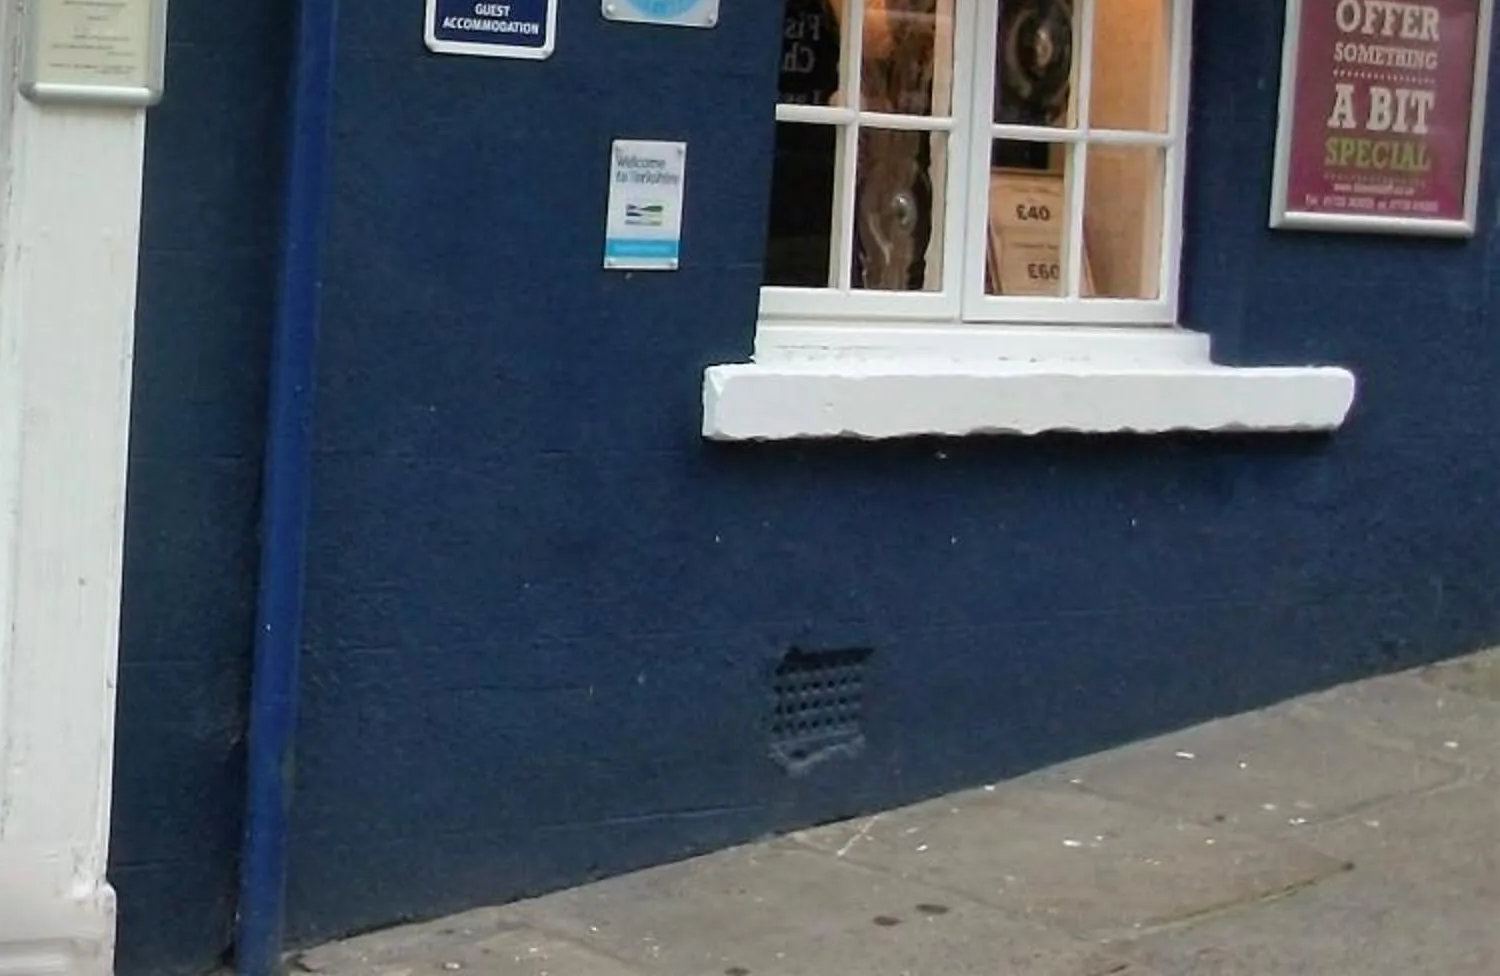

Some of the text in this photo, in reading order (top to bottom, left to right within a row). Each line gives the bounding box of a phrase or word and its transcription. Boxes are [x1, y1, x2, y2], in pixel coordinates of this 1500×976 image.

[475, 3, 510, 17] GUEST
[442, 18, 539, 36] ACCOMMODATION
[1333, 42, 1438, 70] SOMETHING
[1327, 84, 1435, 134] A BIT
[1323, 136, 1432, 173] SPECIAL
[1016, 204, 1050, 221] £40
